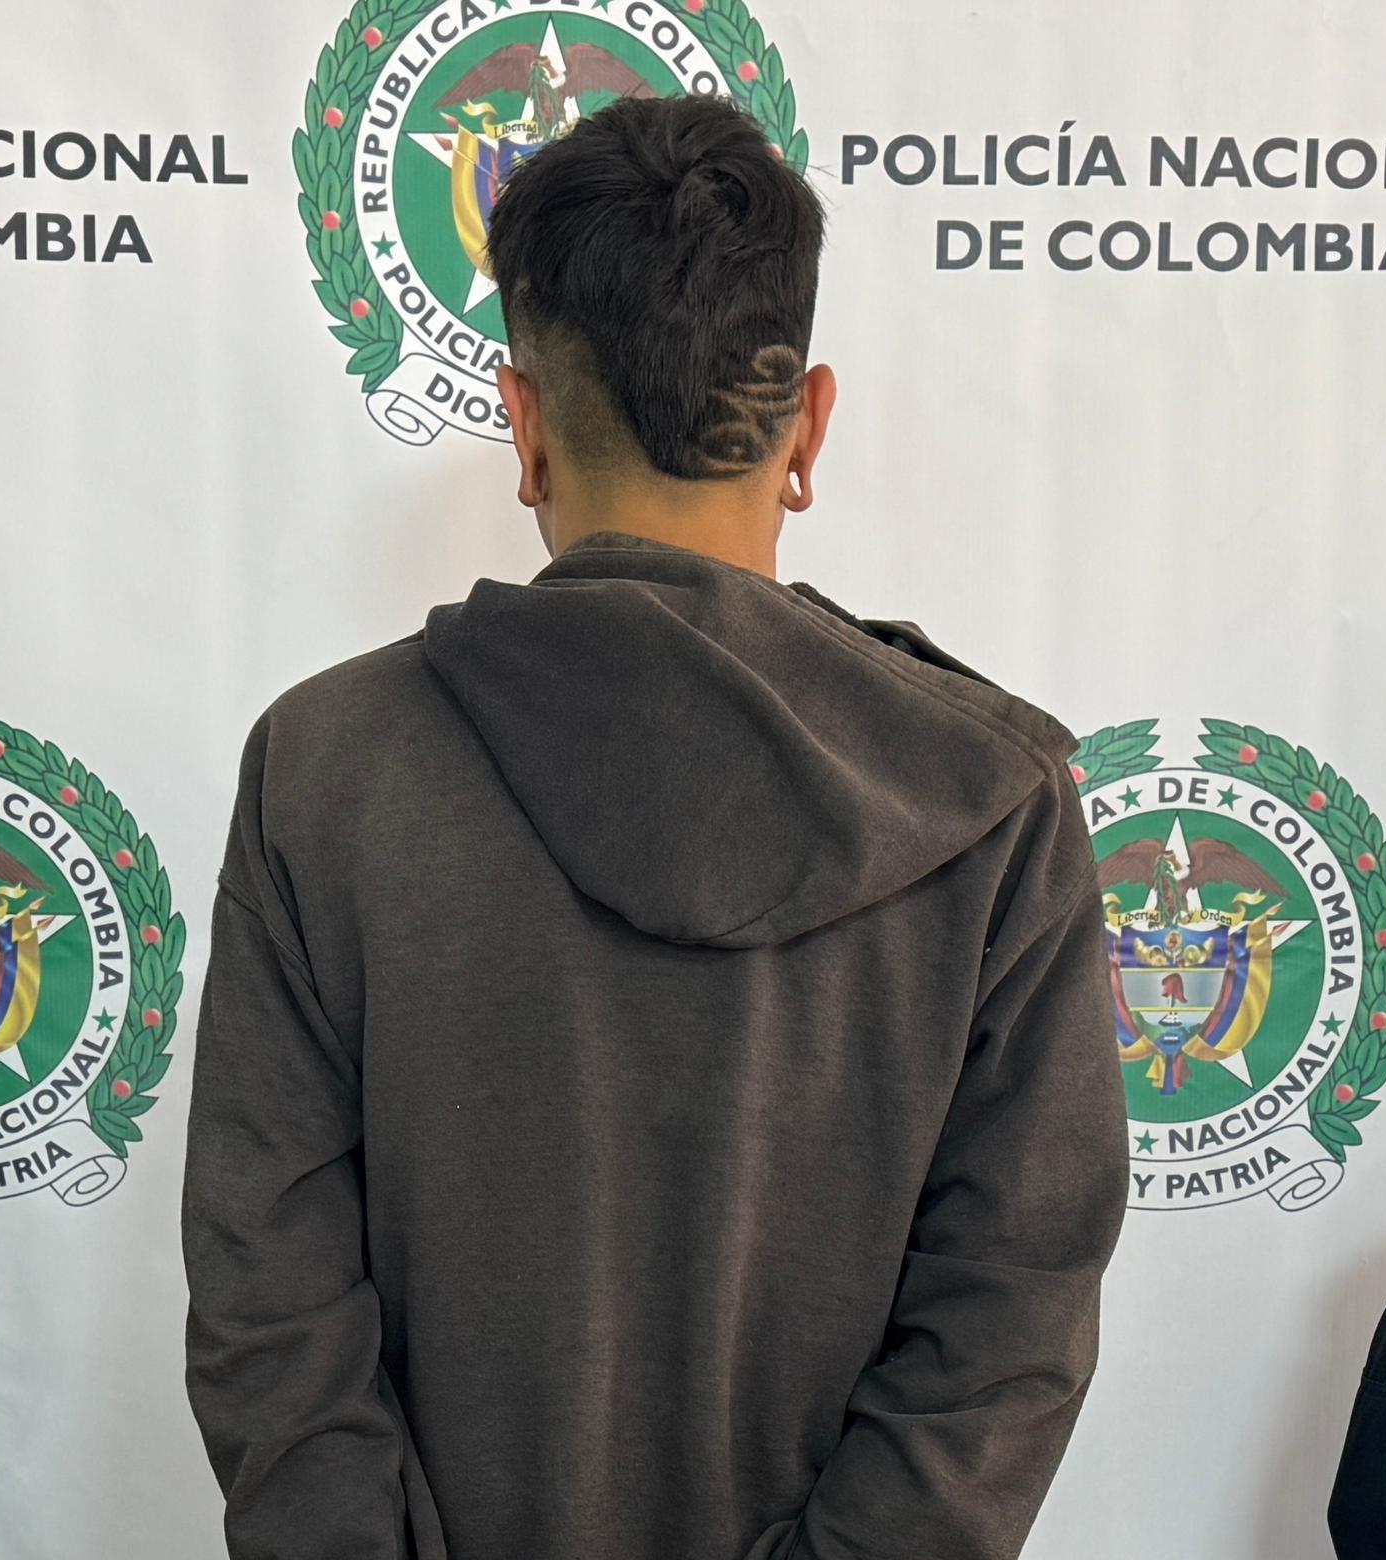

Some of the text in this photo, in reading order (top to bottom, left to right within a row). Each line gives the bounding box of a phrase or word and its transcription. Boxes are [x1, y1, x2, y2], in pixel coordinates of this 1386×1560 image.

[360, 2, 488, 215] REPÚBLICA
[840, 119, 1128, 188] POLICÍA
[935, 219, 1025, 272] DE
[1, 793, 125, 991] COLOMBIA
[1158, 776, 1356, 996] DE COLOMBIA
[1199, 908, 1233, 928] Orden
[1168, 1037, 1337, 1154] NACIONAL
[1132, 1146, 1292, 1200] Y PATRIA
